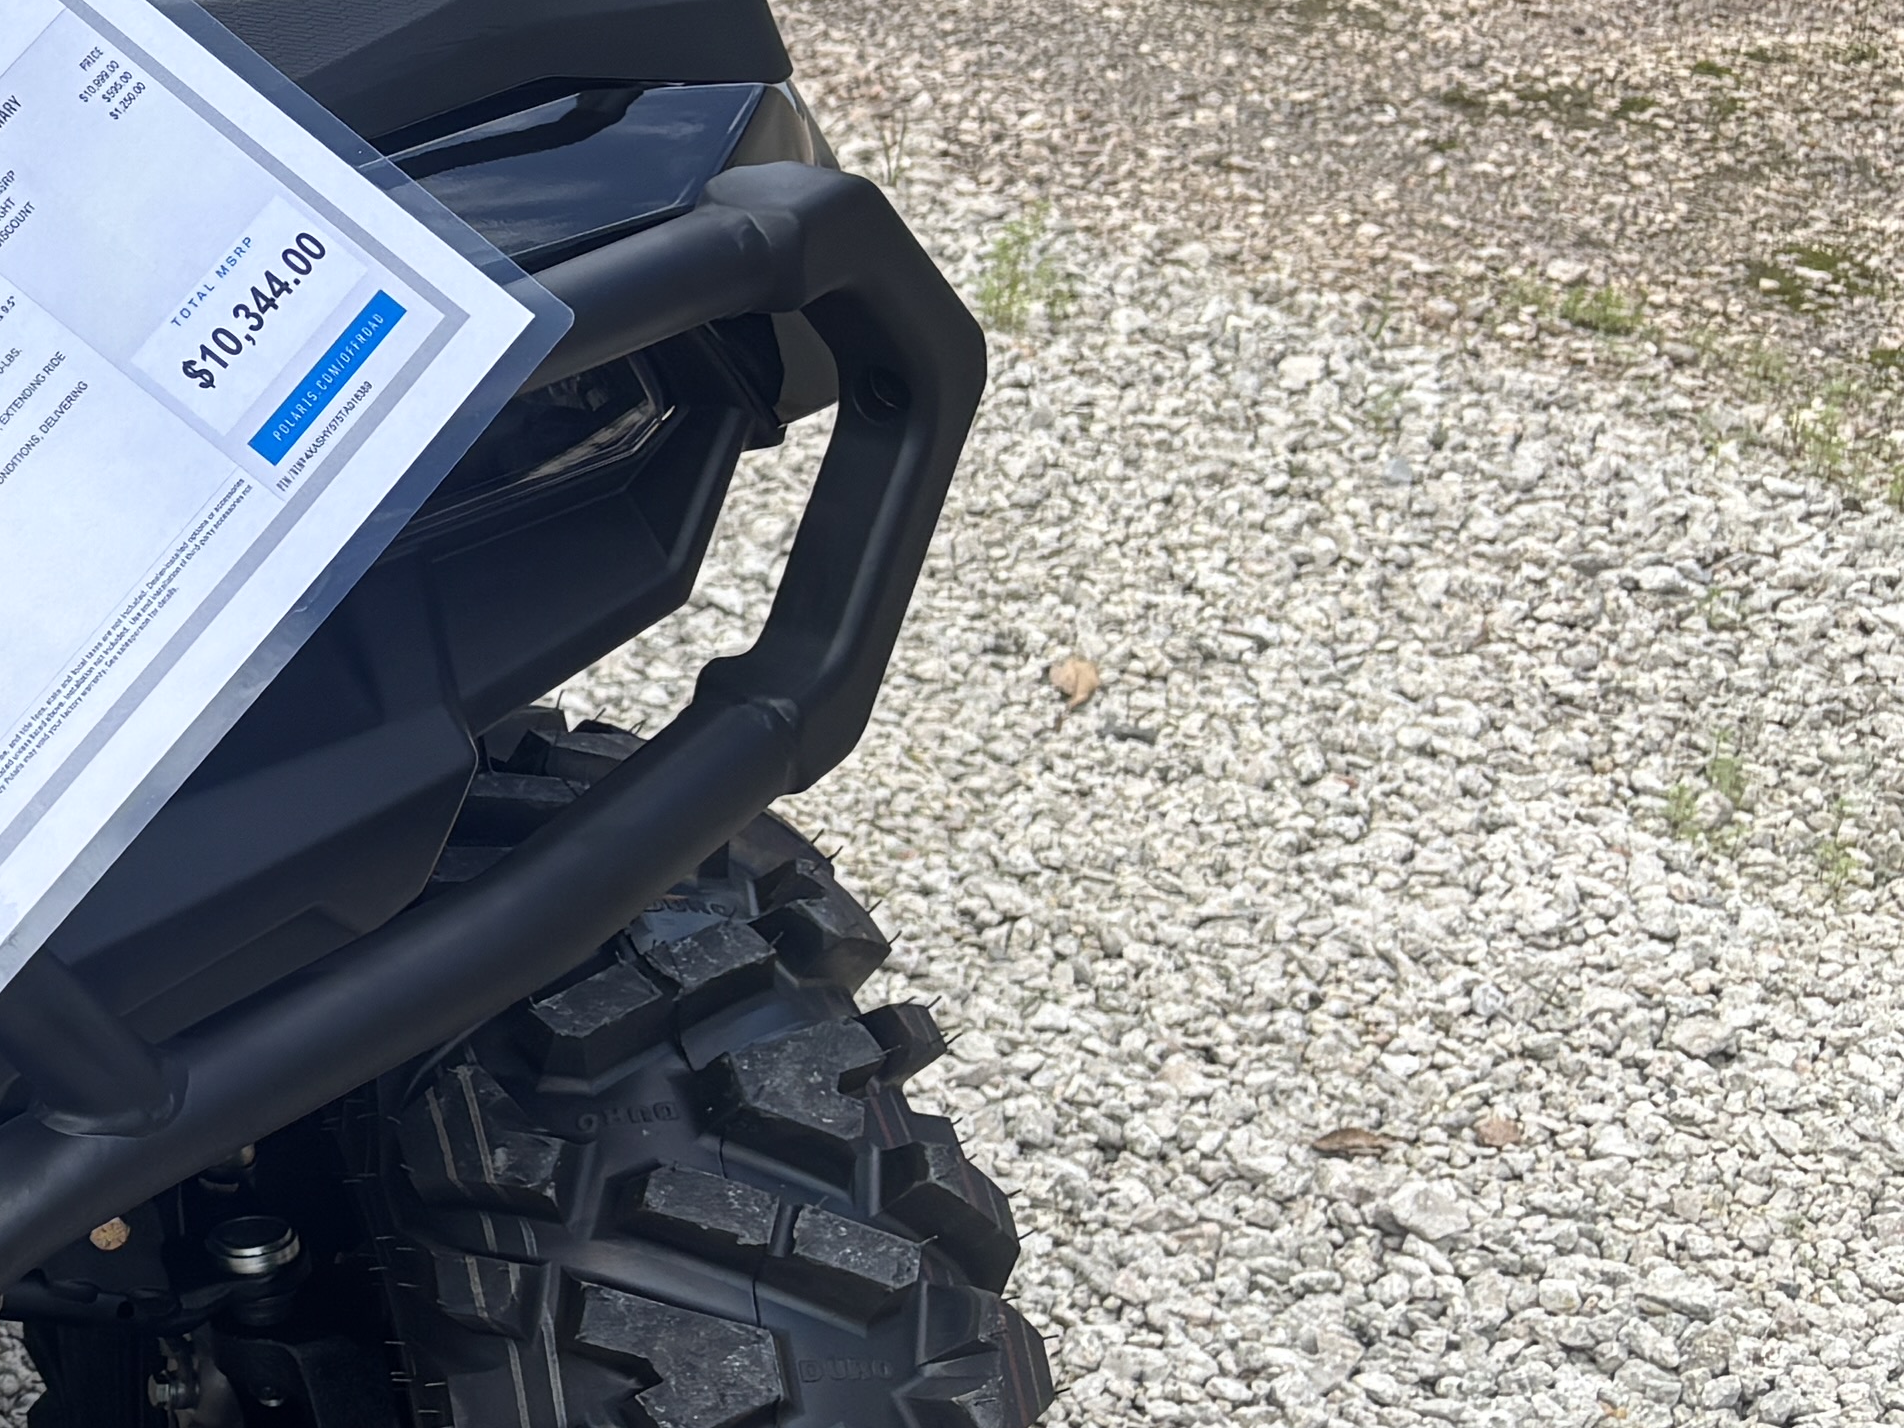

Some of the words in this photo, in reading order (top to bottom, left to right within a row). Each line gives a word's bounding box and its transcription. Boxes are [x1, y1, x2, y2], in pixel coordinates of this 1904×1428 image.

[79, 46, 104, 71] PRICE
[109, 81, 146, 120] $1,250.00
[170, 284, 215, 327] TOTAL
[215, 237, 251, 278] MSRP
[182, 232, 326, 389] $10,344.00
[42, 351, 66, 376] RIDE
[39, 380, 88, 434] DELIVERING
[798, 1358, 894, 1384] DURO
